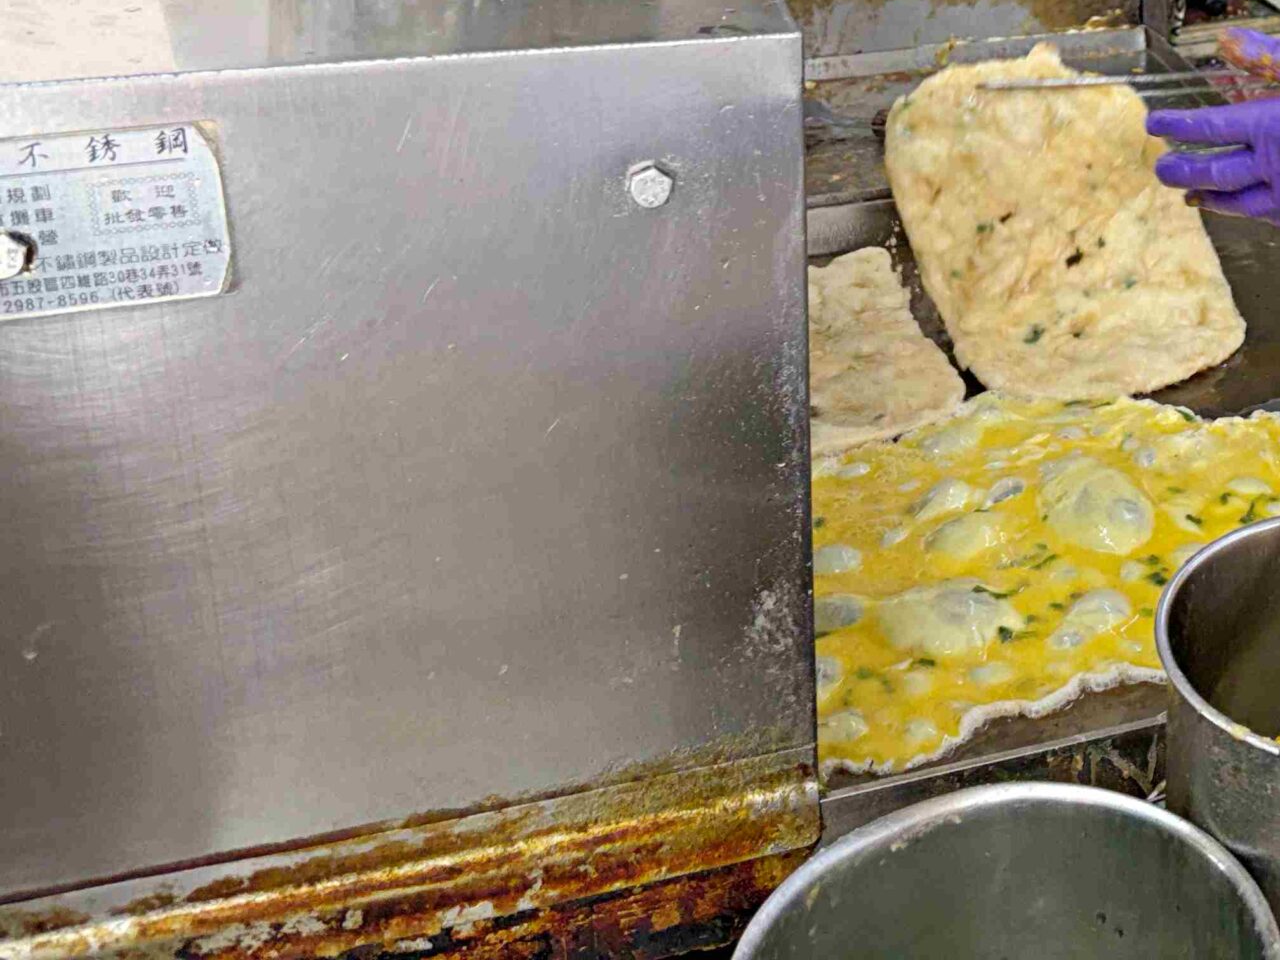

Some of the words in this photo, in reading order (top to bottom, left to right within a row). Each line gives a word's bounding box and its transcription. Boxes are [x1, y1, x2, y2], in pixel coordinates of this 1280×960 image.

[18, 127, 188, 167] 不銹鋼
[0, 207, 54, 228] 攤車
